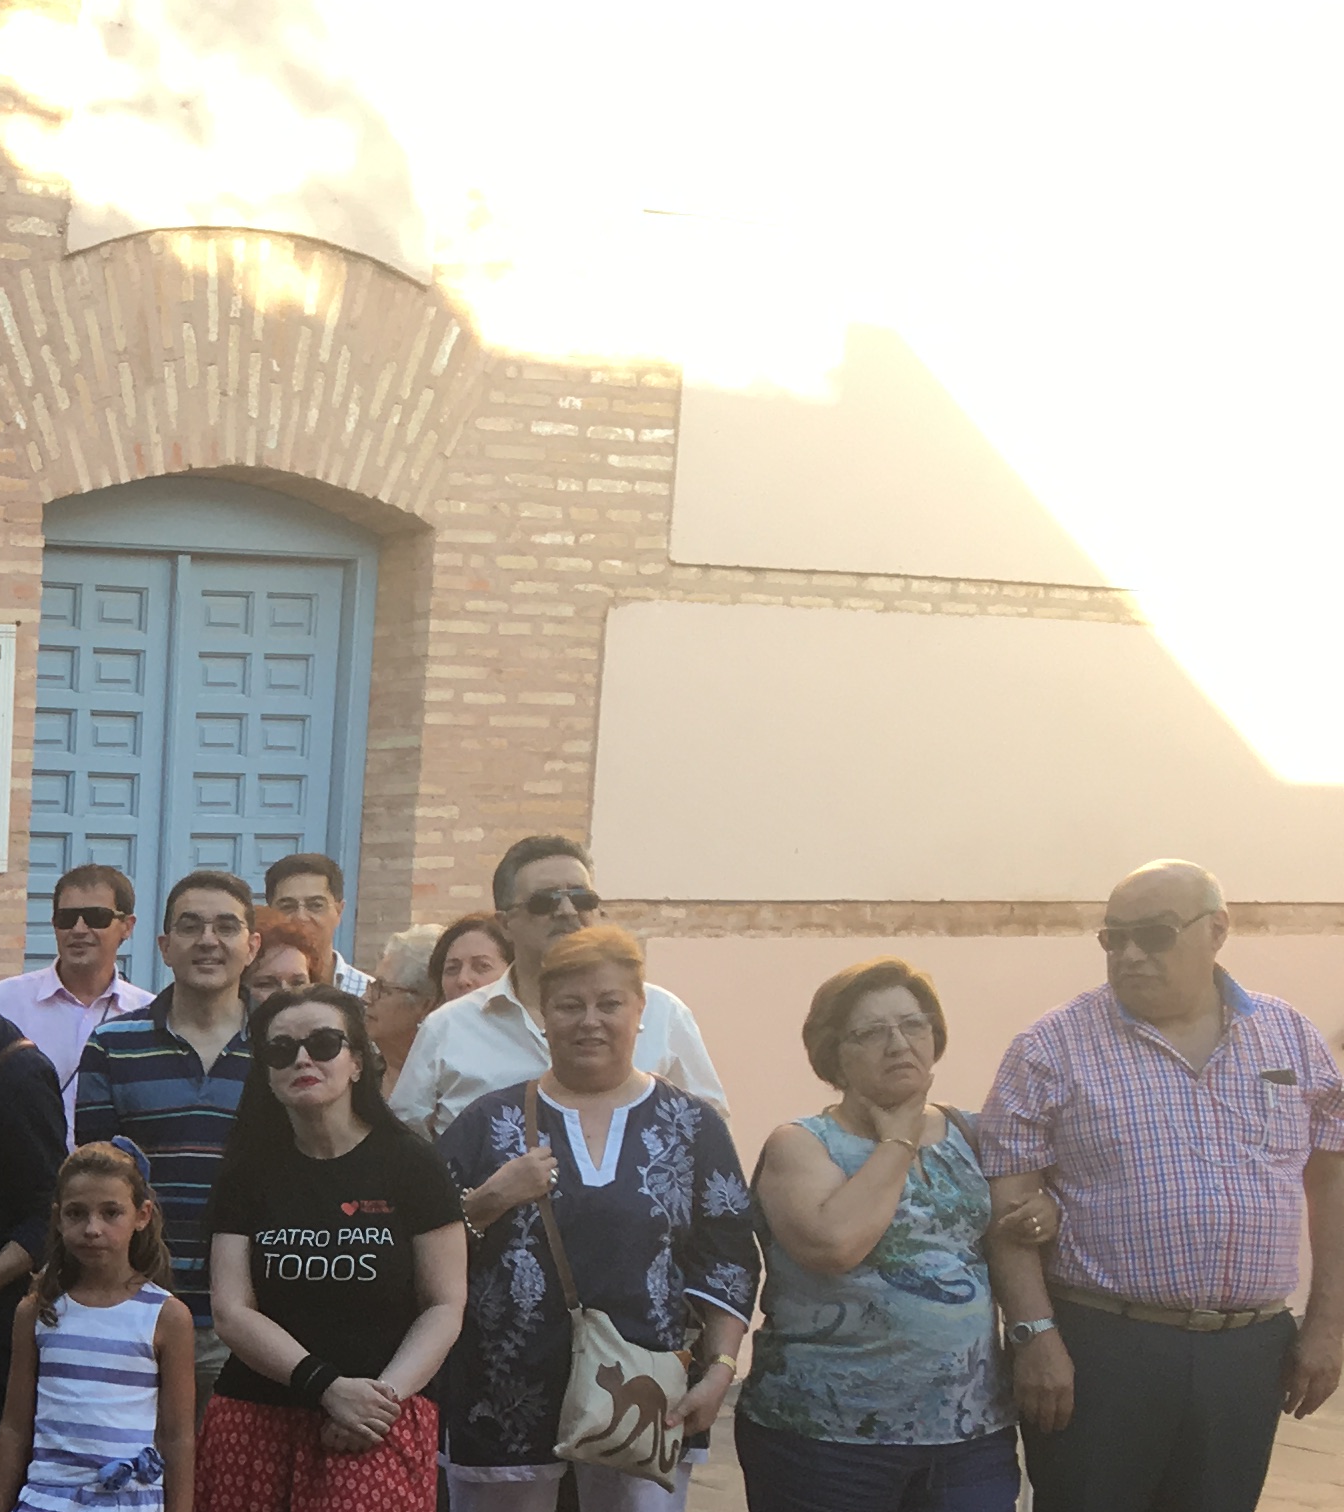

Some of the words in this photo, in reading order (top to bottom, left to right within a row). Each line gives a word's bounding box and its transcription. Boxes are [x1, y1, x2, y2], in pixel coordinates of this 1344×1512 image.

[255, 1228, 330, 1248] TEATRO
[337, 1227, 394, 1247] PARA
[264, 1252, 377, 1282] TODOS
